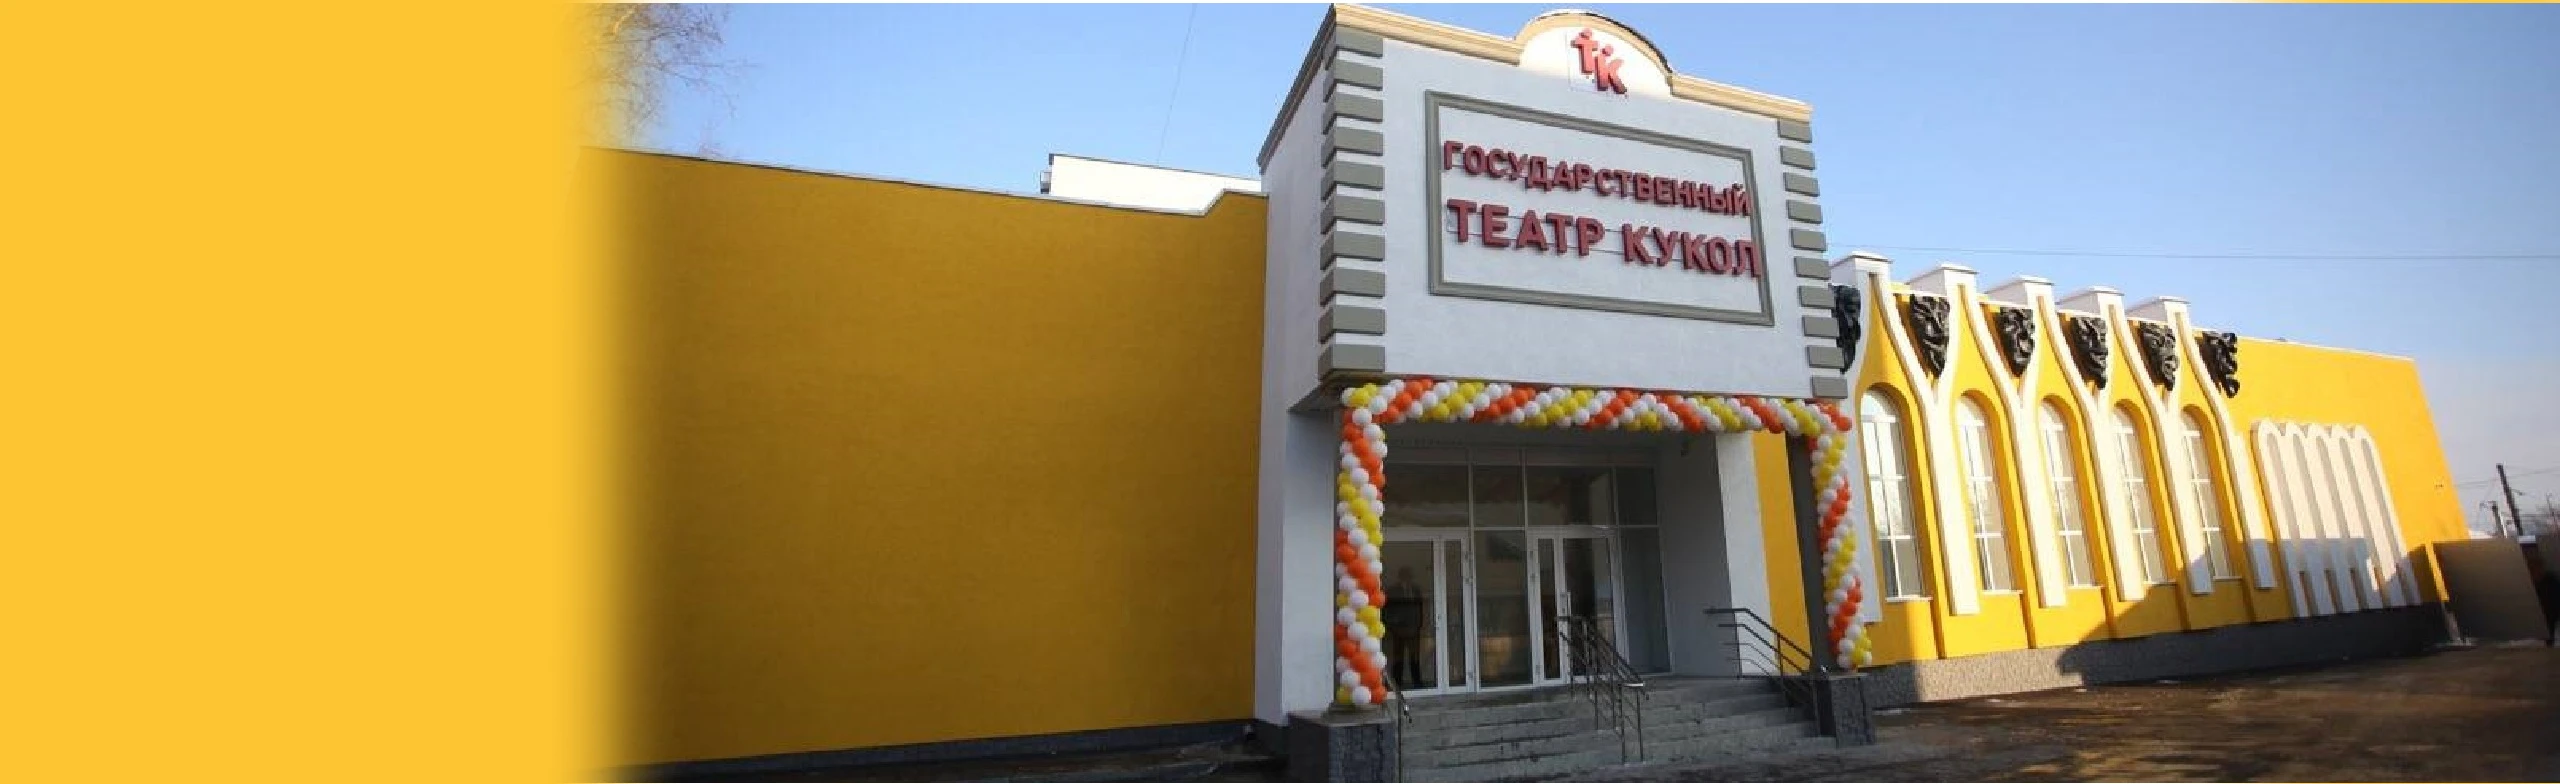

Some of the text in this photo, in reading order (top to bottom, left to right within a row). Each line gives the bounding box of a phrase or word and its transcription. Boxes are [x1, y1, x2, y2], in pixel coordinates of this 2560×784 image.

[1443, 140, 1751, 217] ГОСУДАРСТВЕННЫЙ
[1447, 199, 1762, 279] ТЕАТР КУКОЛ
